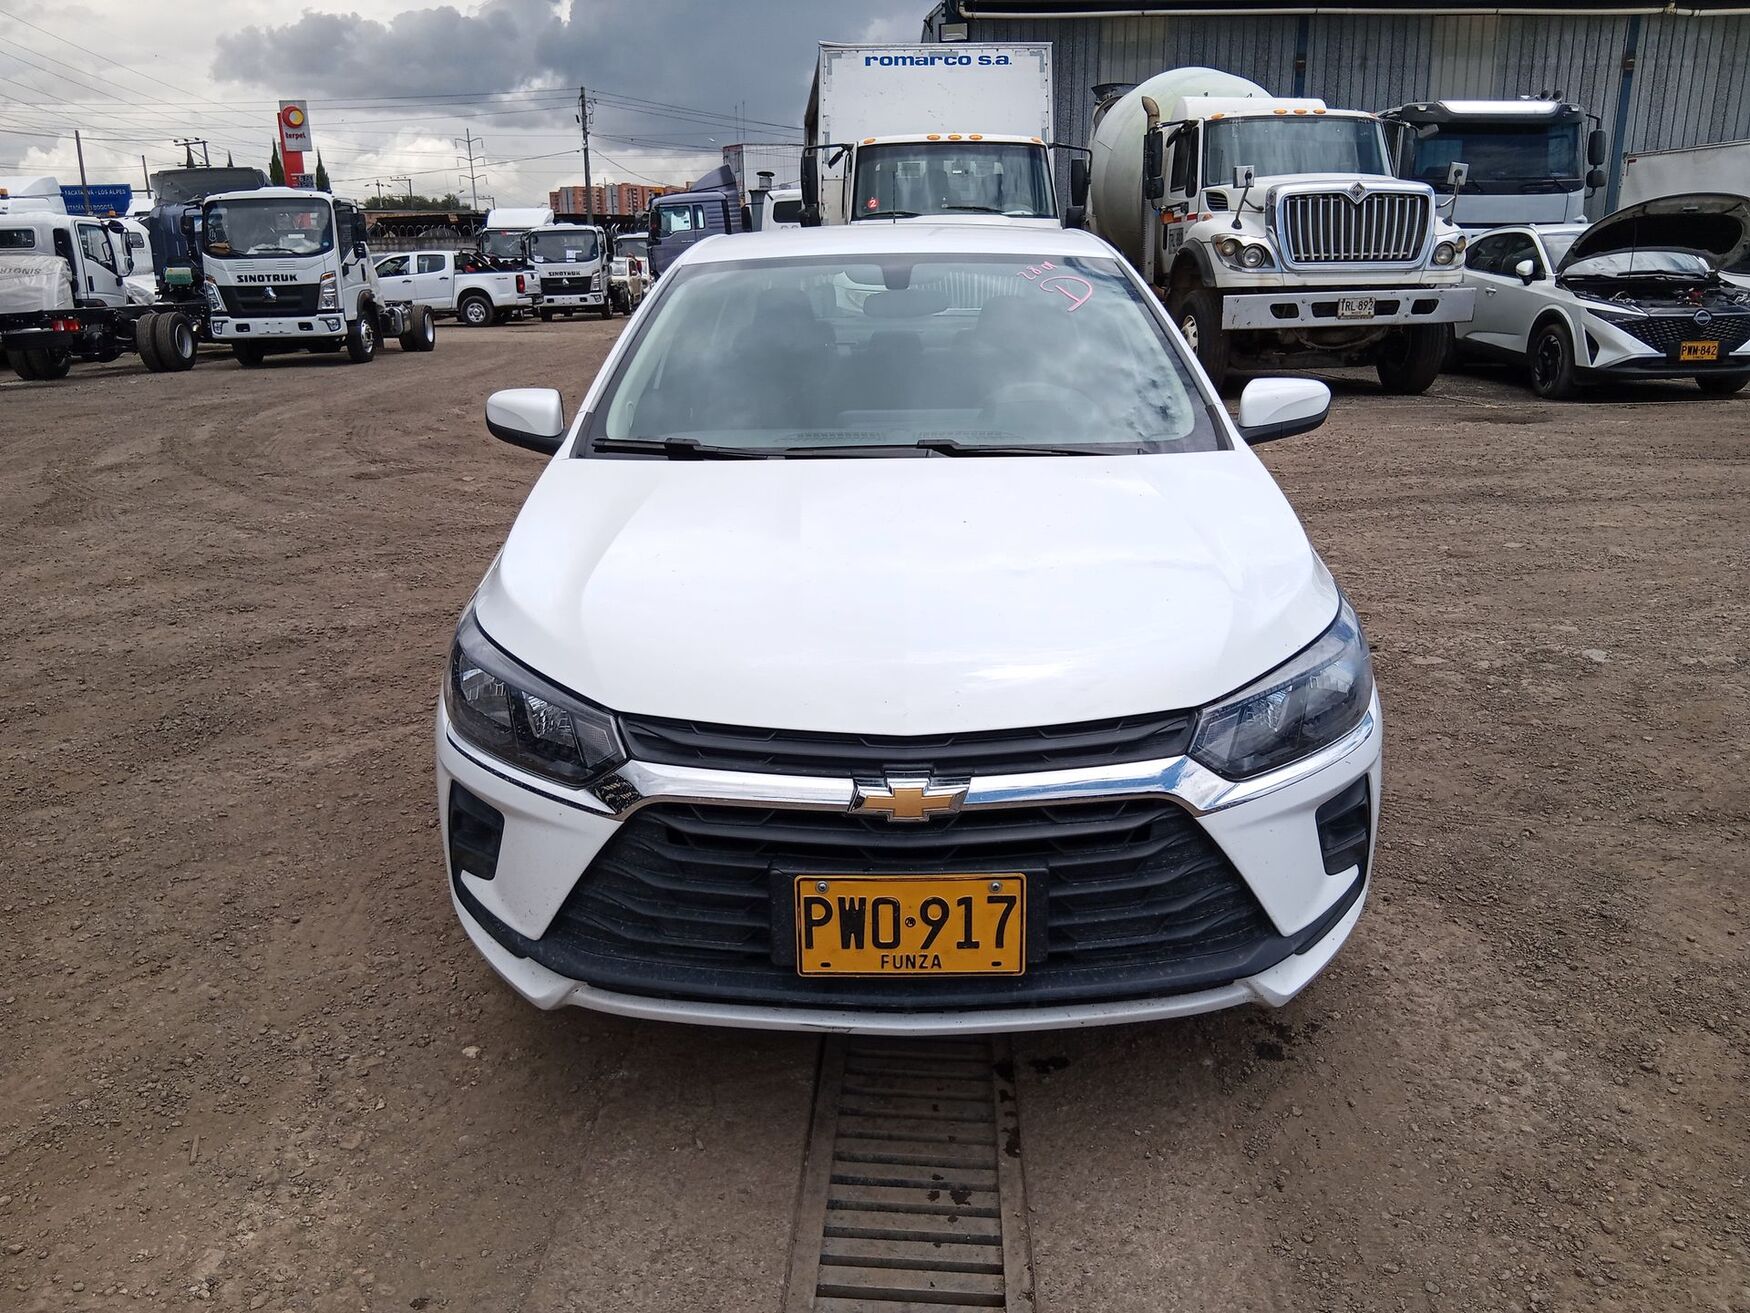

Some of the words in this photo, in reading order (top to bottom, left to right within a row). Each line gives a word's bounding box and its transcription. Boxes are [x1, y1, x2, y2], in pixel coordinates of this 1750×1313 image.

[865, 55, 971, 67] romarco
[978, 55, 1013, 66] s.a.
[285, 131, 306, 140] terpel
[236, 274, 298, 283] SINOTRUK
[880, 954, 942, 969] FUNZA
